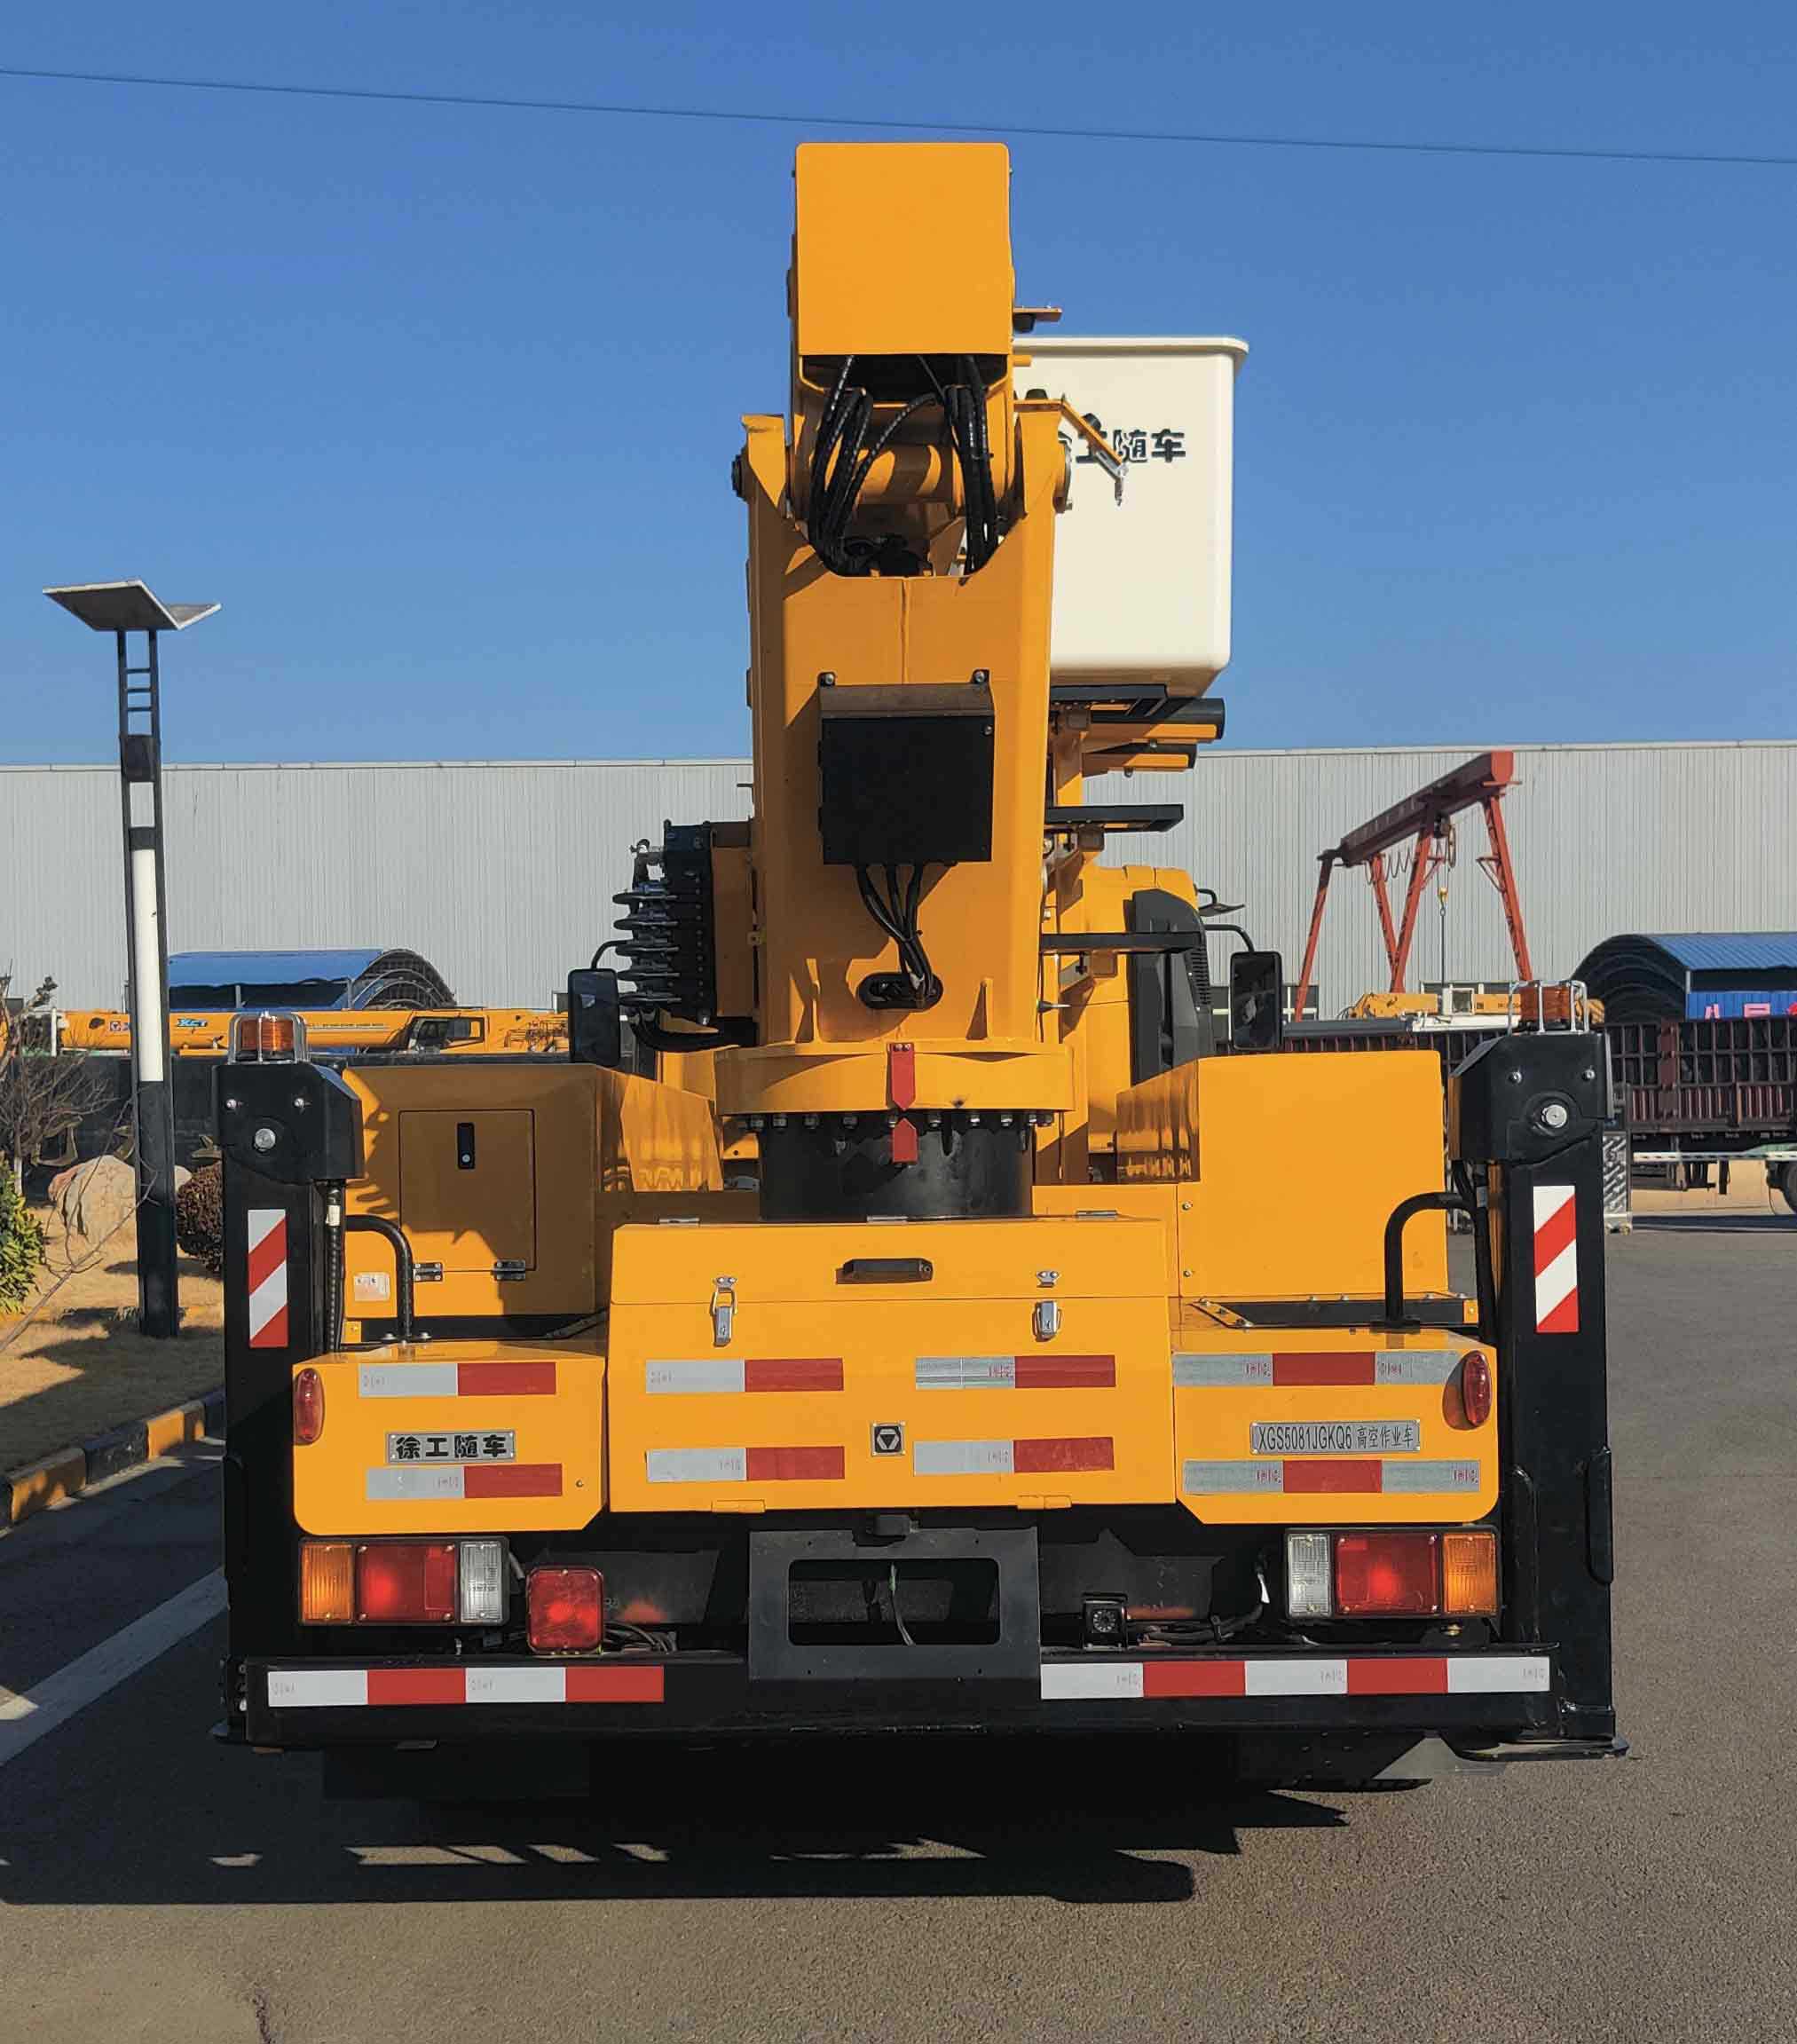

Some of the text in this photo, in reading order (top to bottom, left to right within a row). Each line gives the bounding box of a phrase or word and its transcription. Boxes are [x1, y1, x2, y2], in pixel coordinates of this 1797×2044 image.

[1059, 429, 1186, 463] 工随车
[396, 1434, 507, 1460] 徐工随车
[1258, 1424, 1414, 1450] XGS5081JGKQ6 高空作业车
